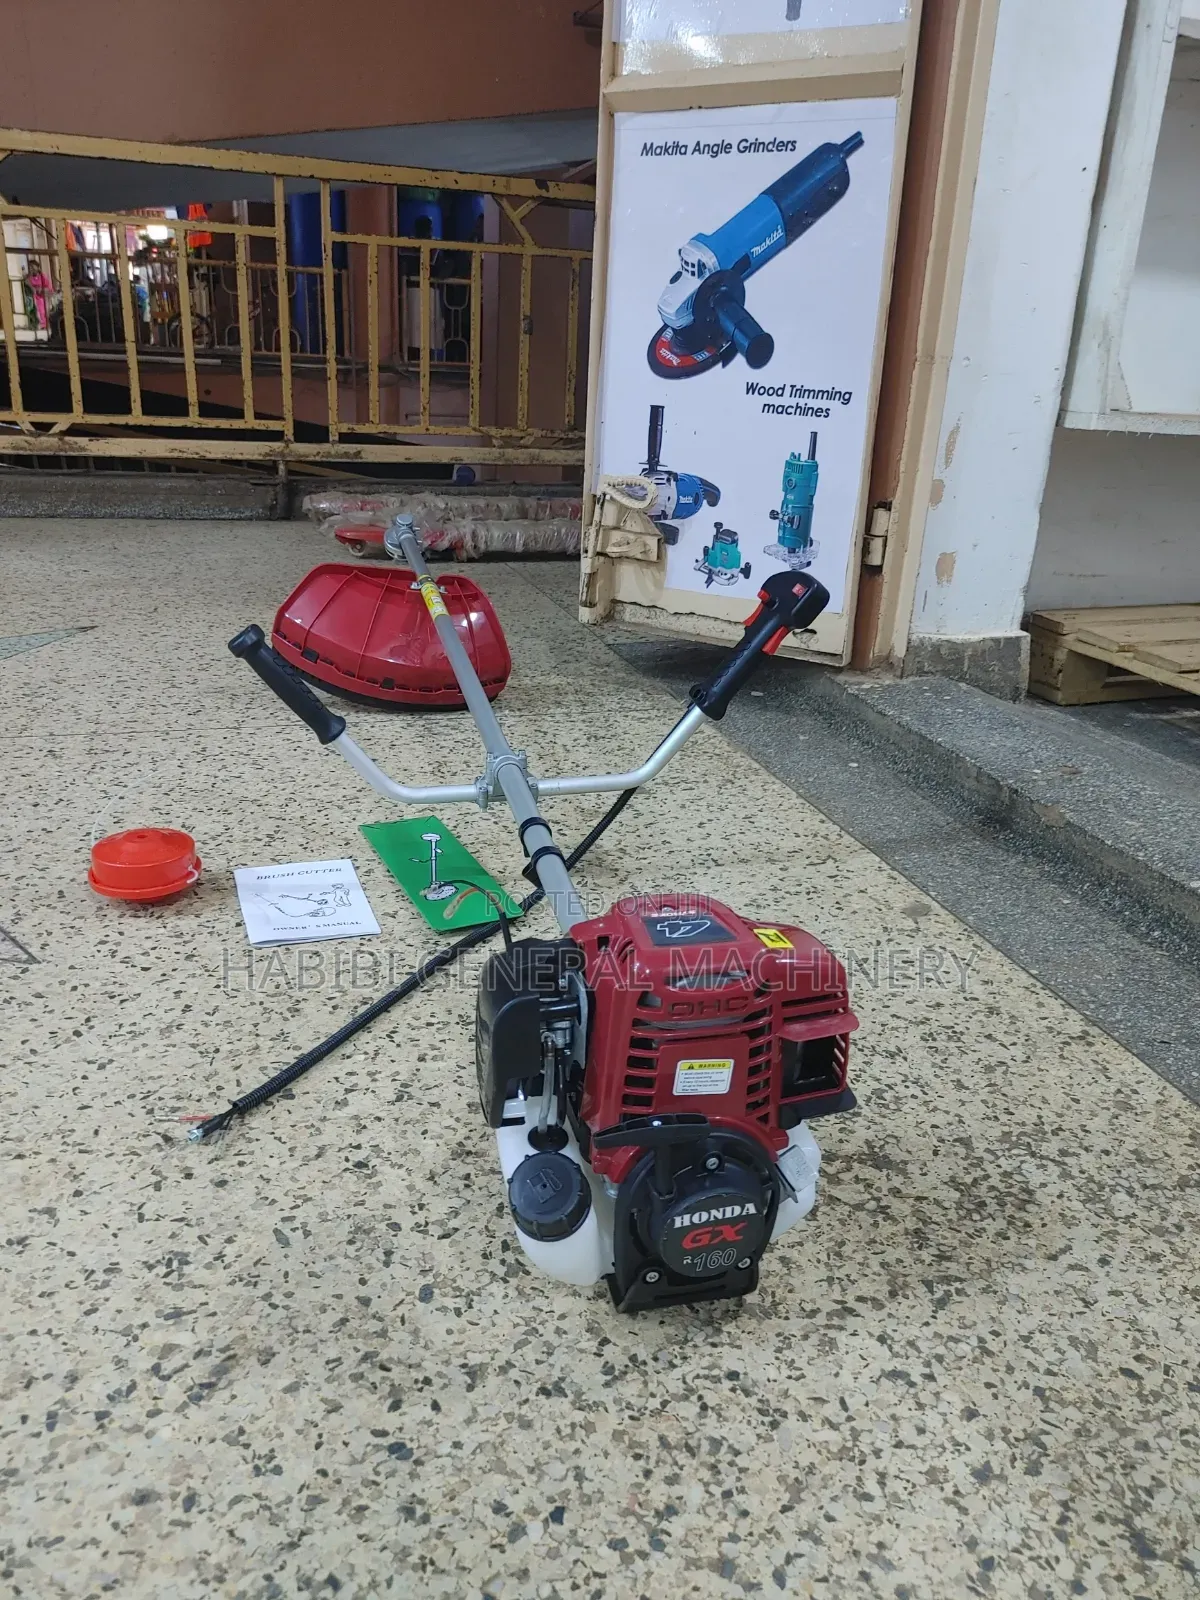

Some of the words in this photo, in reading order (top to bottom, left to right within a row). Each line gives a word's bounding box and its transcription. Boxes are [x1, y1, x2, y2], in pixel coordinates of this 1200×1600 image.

[640, 140, 688, 157] Makita
[691, 139, 733, 159] Angle
[736, 137, 798, 154] Grinders
[745, 381, 786, 398] Wood
[788, 384, 853, 406] Trimming
[761, 402, 831, 418] machines
[256, 871, 295, 880] BRUSH
[297, 867, 343, 876] CUTTER
[673, 1202, 757, 1229] HONDA
[681, 1219, 748, 1250] GX
